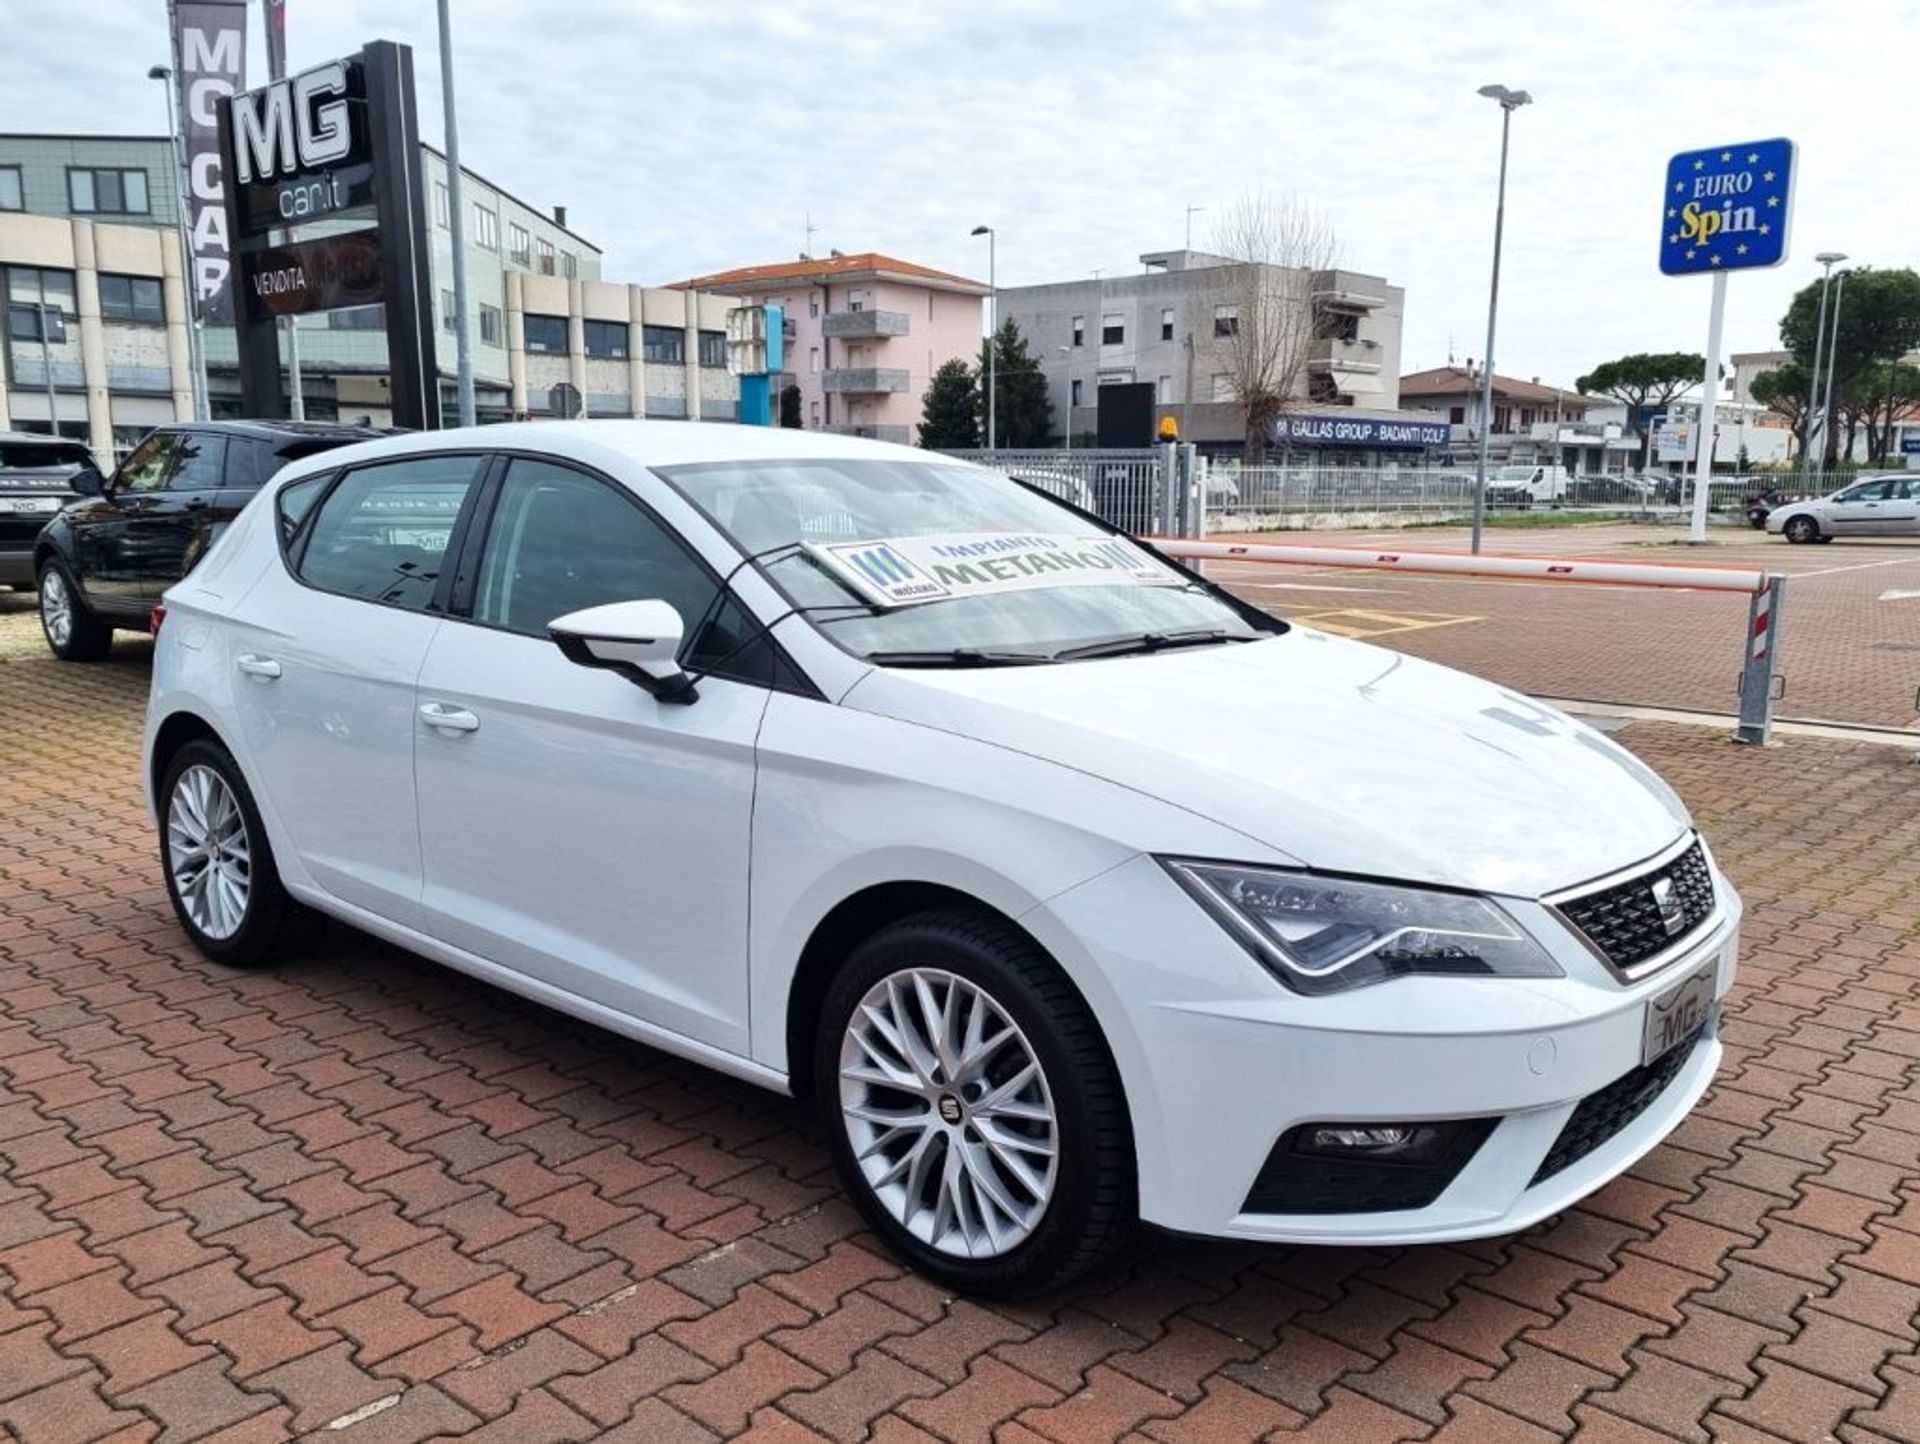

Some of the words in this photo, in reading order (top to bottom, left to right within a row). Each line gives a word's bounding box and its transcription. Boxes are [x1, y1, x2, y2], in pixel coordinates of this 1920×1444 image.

[231, 59, 350, 184] MG
[279, 175, 340, 218] car.it
[1694, 171, 1753, 198] EURO
[1680, 199, 1757, 247] Spin
[253, 266, 307, 296] VENDITA
[1291, 420, 1334, 439] GALLAS
[1335, 422, 1373, 441] GROUP
[1379, 424, 1421, 443] BADANTI
[930, 534, 1058, 558] IMPIANTO
[931, 551, 1114, 586] METANO
